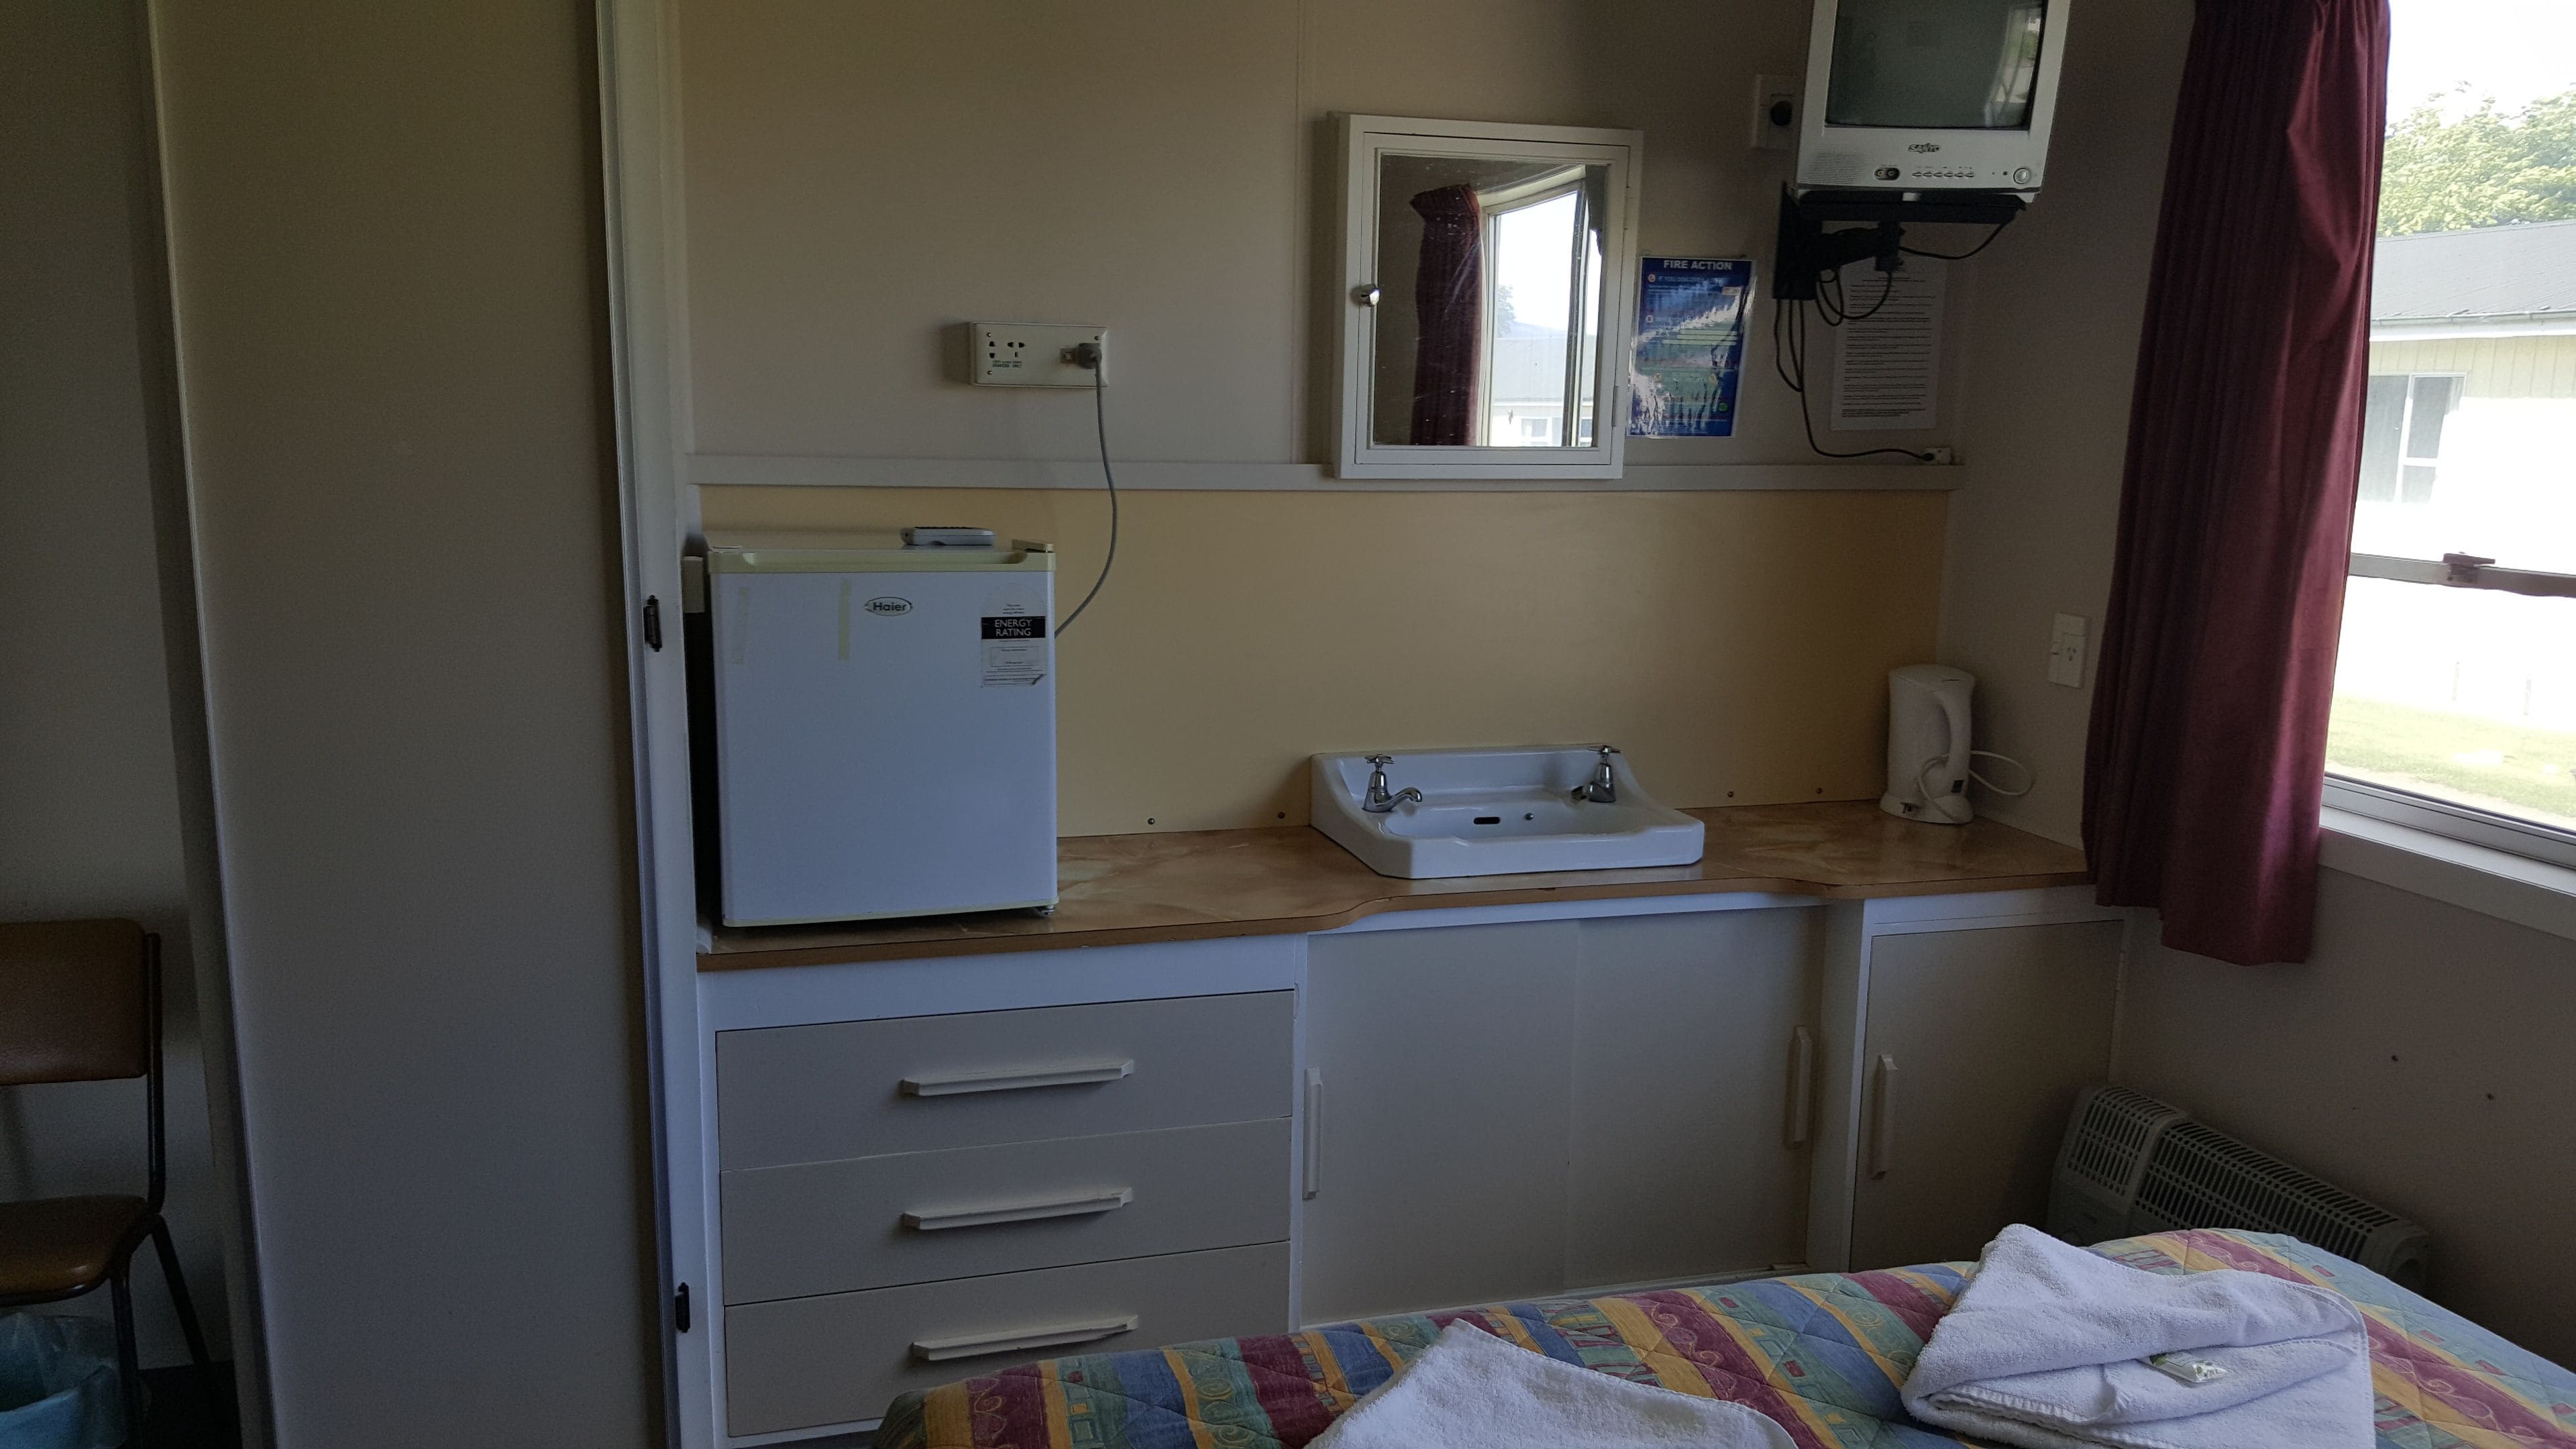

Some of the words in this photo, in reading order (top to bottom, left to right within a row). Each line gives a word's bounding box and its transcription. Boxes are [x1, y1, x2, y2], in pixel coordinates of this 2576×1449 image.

[1663, 260, 1688, 269] FIRE
[1690, 262, 1733, 270] ACTION
[873, 602, 907, 611] Haier
[994, 619, 1033, 628] ENERGY
[996, 628, 1031, 637] RATING
